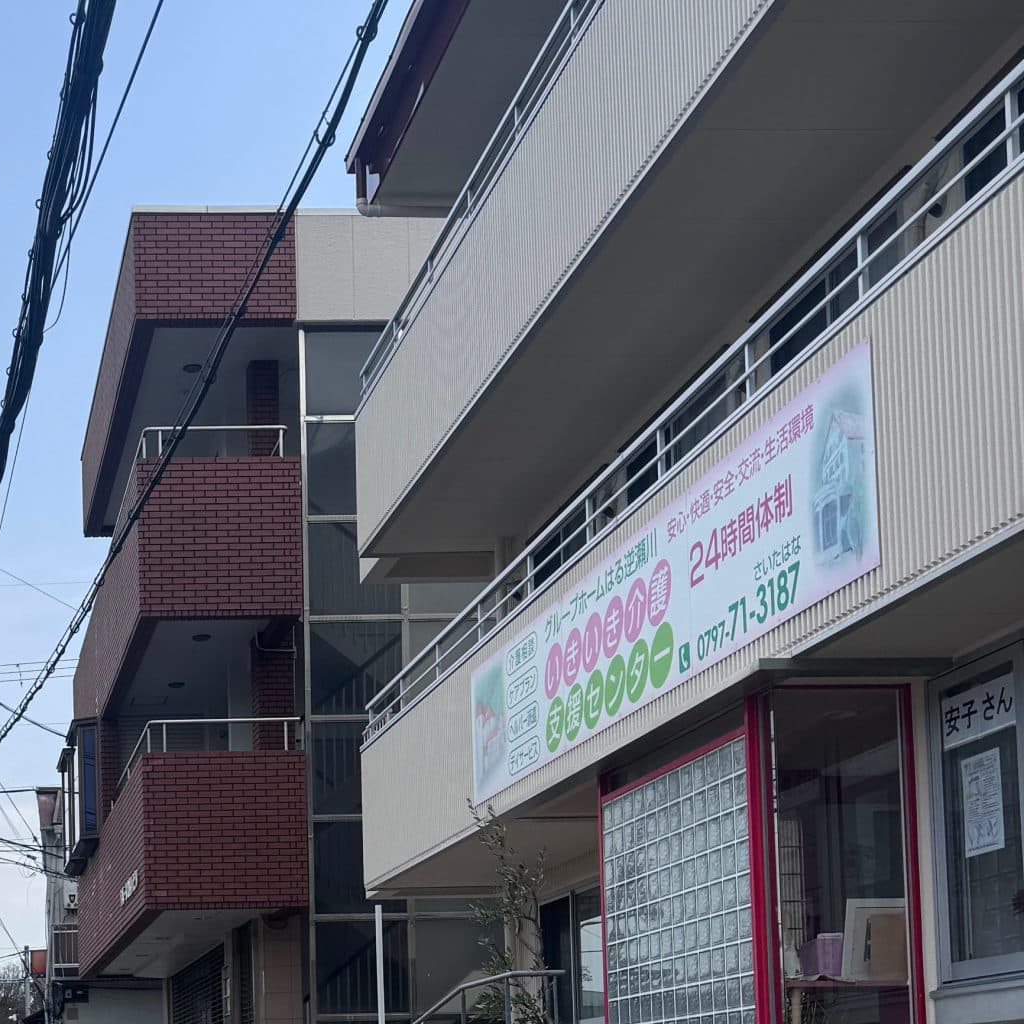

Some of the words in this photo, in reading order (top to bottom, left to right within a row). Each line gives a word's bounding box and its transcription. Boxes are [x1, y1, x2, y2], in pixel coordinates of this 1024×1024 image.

[689, 474, 793, 588] 24時間体制
[753, 535, 801, 581] さいたはな
[545, 528, 658, 643] グループホームはる逆瀬川
[547, 564, 670, 699] いきいき介護
[697, 560, 800, 661] 0797-71-3187
[548, 647, 671, 747] 支援センター
[945, 687, 1013, 737] 安子さん
[511, 741, 539, 771] デイサービス
